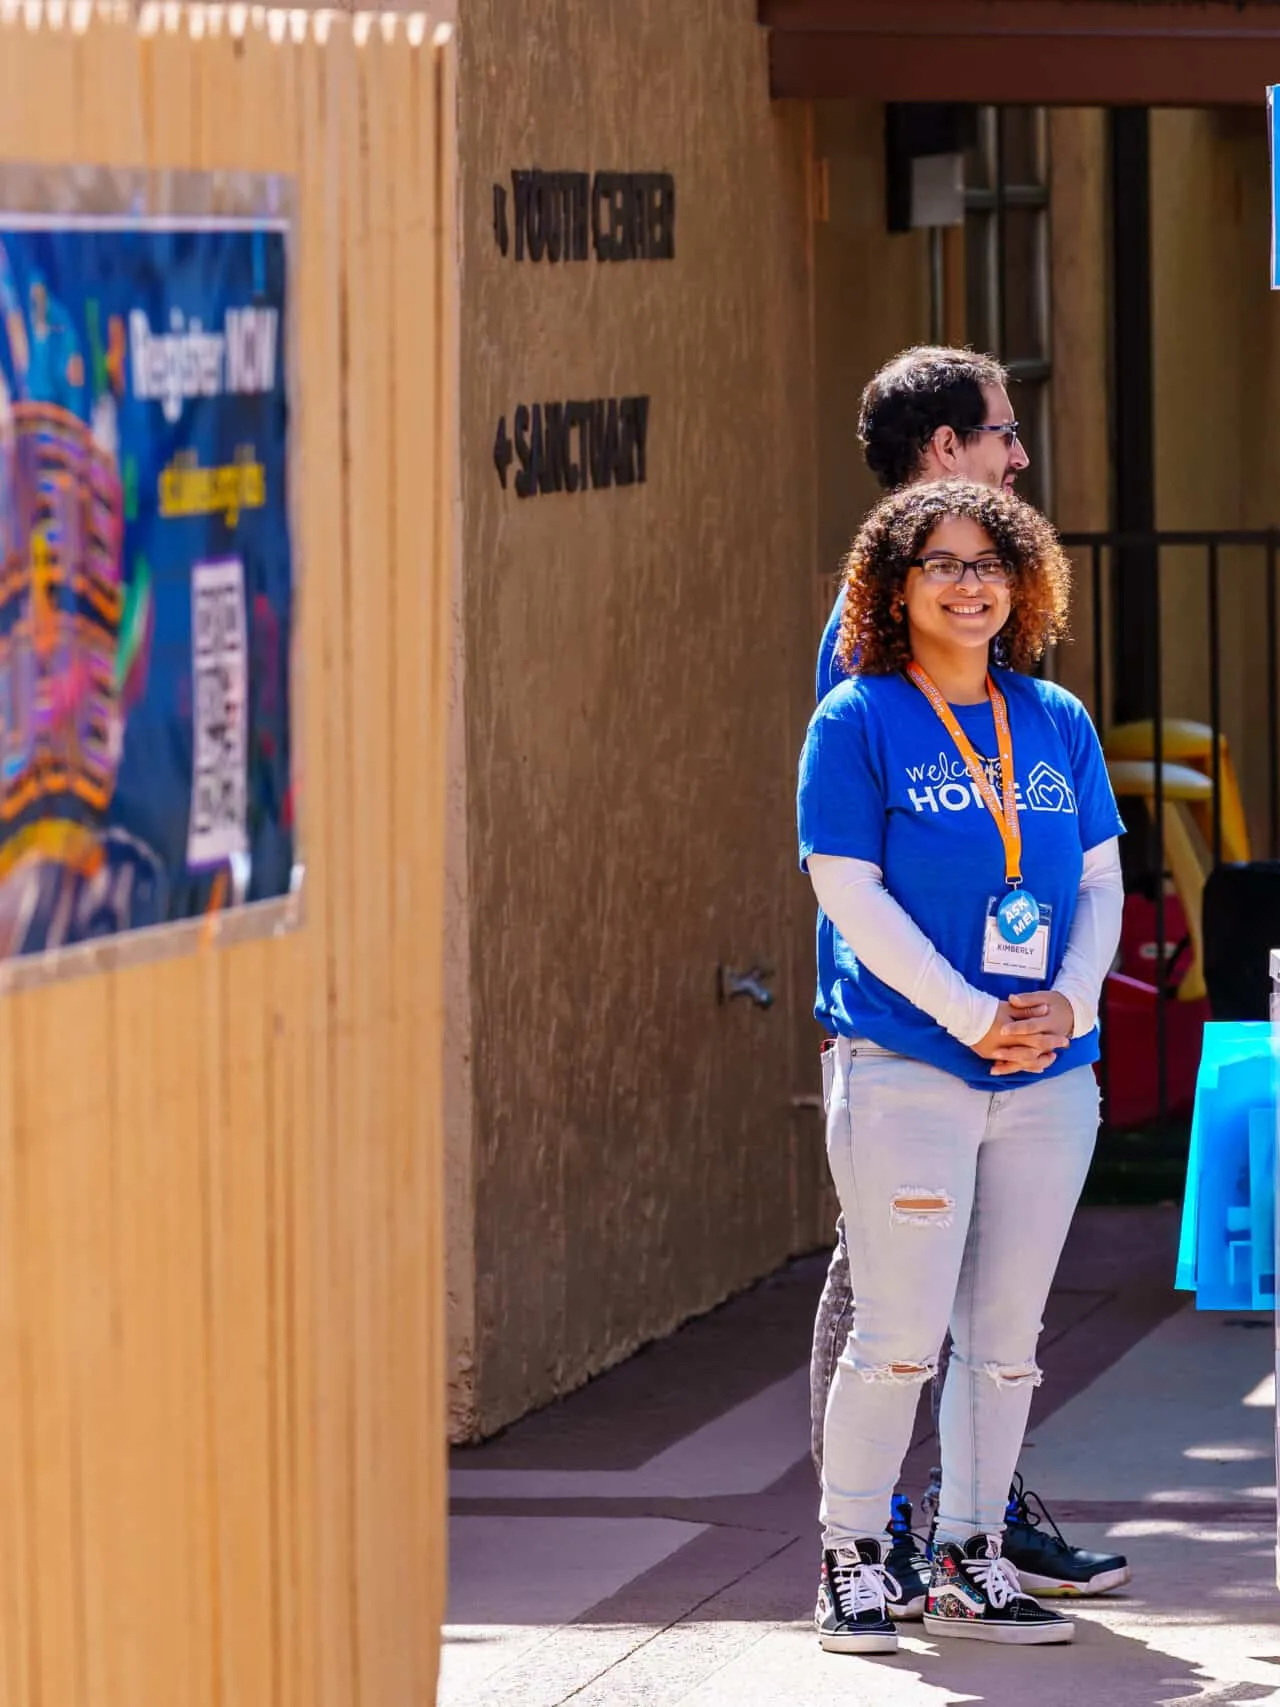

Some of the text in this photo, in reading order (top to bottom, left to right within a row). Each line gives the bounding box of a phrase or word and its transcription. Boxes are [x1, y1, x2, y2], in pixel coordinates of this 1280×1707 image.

[511, 168, 677, 263] YOUTH CENTER
[514, 395, 651, 499] SANCTUARY
[905, 751, 1001, 789] welc
[1005, 895, 1029, 924] ASK
[997, 943, 1035, 955] KIMBERLY
